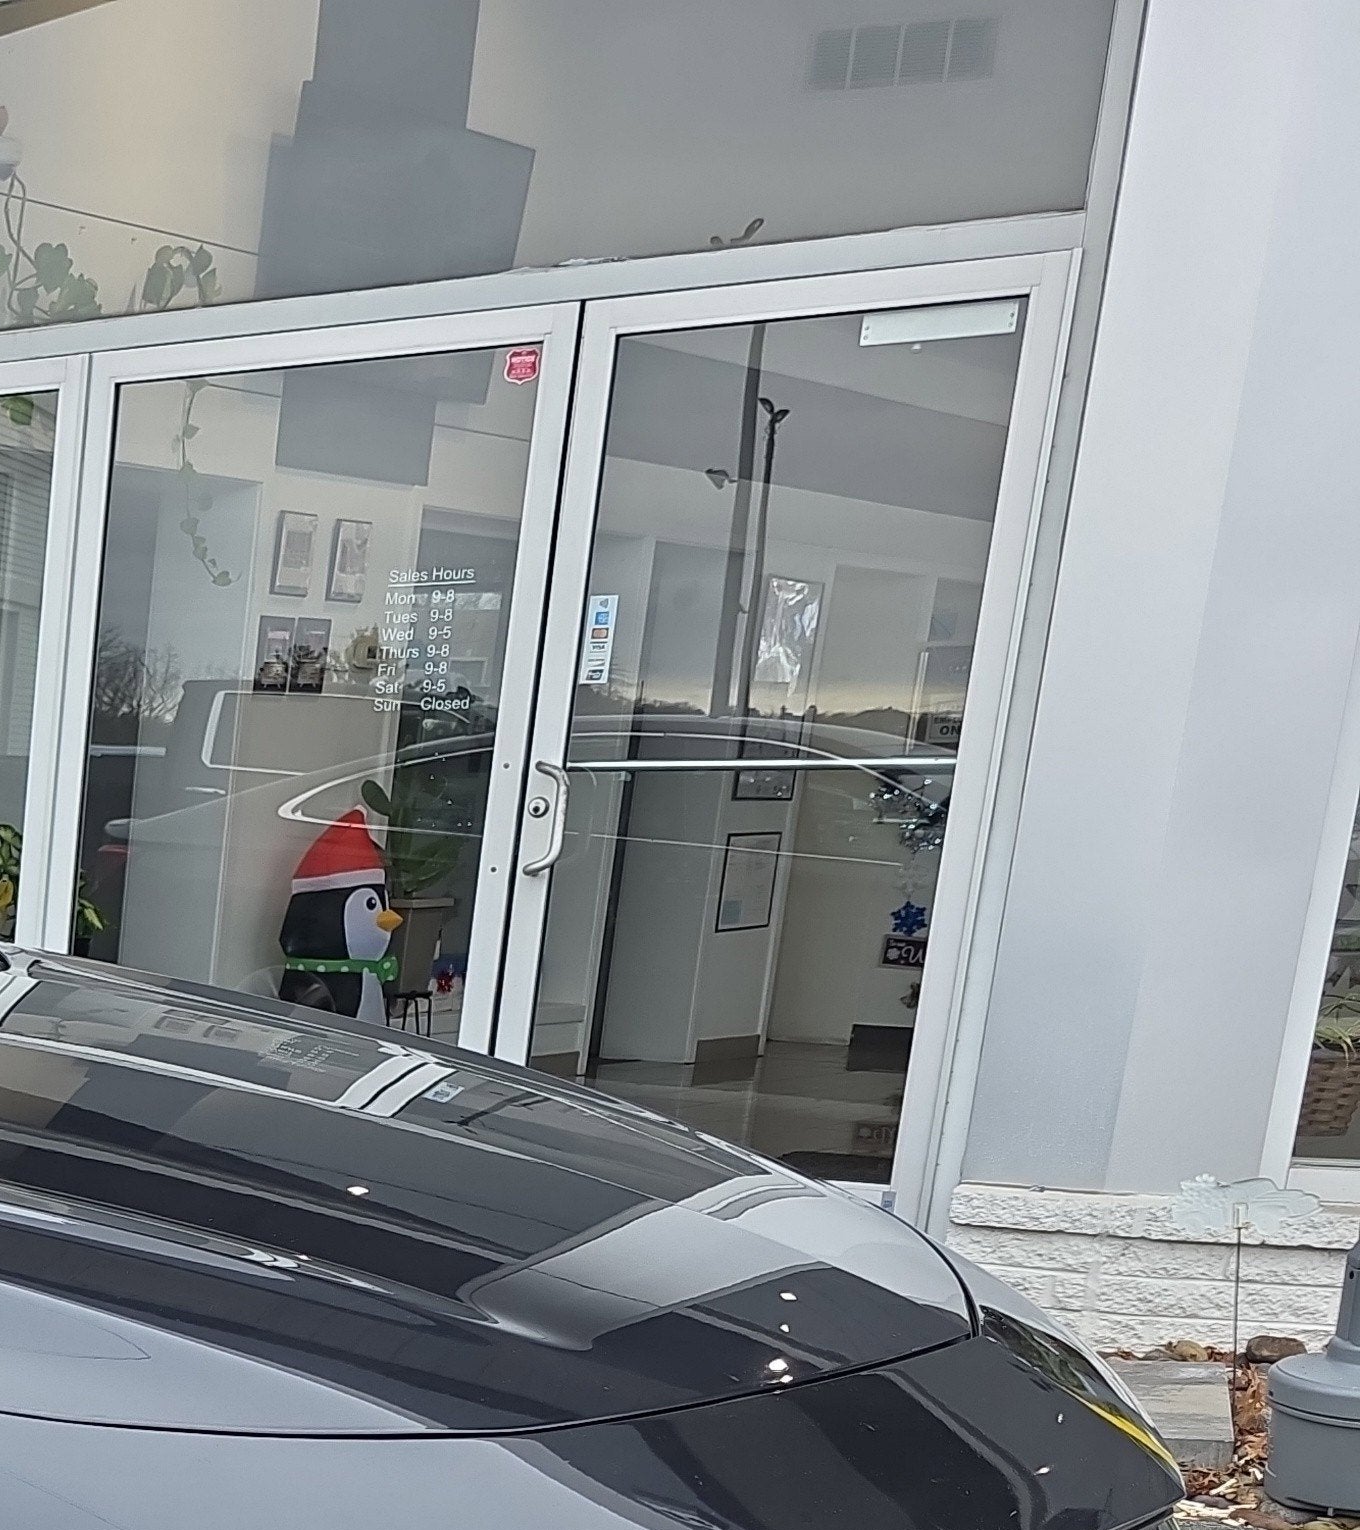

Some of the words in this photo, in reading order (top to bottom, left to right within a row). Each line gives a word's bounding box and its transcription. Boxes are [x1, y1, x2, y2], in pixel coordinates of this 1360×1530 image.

[388, 569, 428, 583] Sales
[432, 566, 475, 581] Hours
[385, 592, 416, 605] Mon
[432, 589, 455, 603] 9-8
[384, 611, 418, 623] Tues
[430, 609, 453, 622] 9-8
[381, 628, 414, 641] Wed
[428, 626, 452, 640] 9-5
[380, 646, 420, 659] Thurs
[426, 644, 450, 657] 9-8
[377, 664, 396, 677] Fri
[424, 662, 447, 675] 9-8
[375, 681, 399, 695] Sat
[423, 679, 446, 692] 9-5
[373, 699, 401, 712] Sun
[420, 697, 470, 710] Closed
